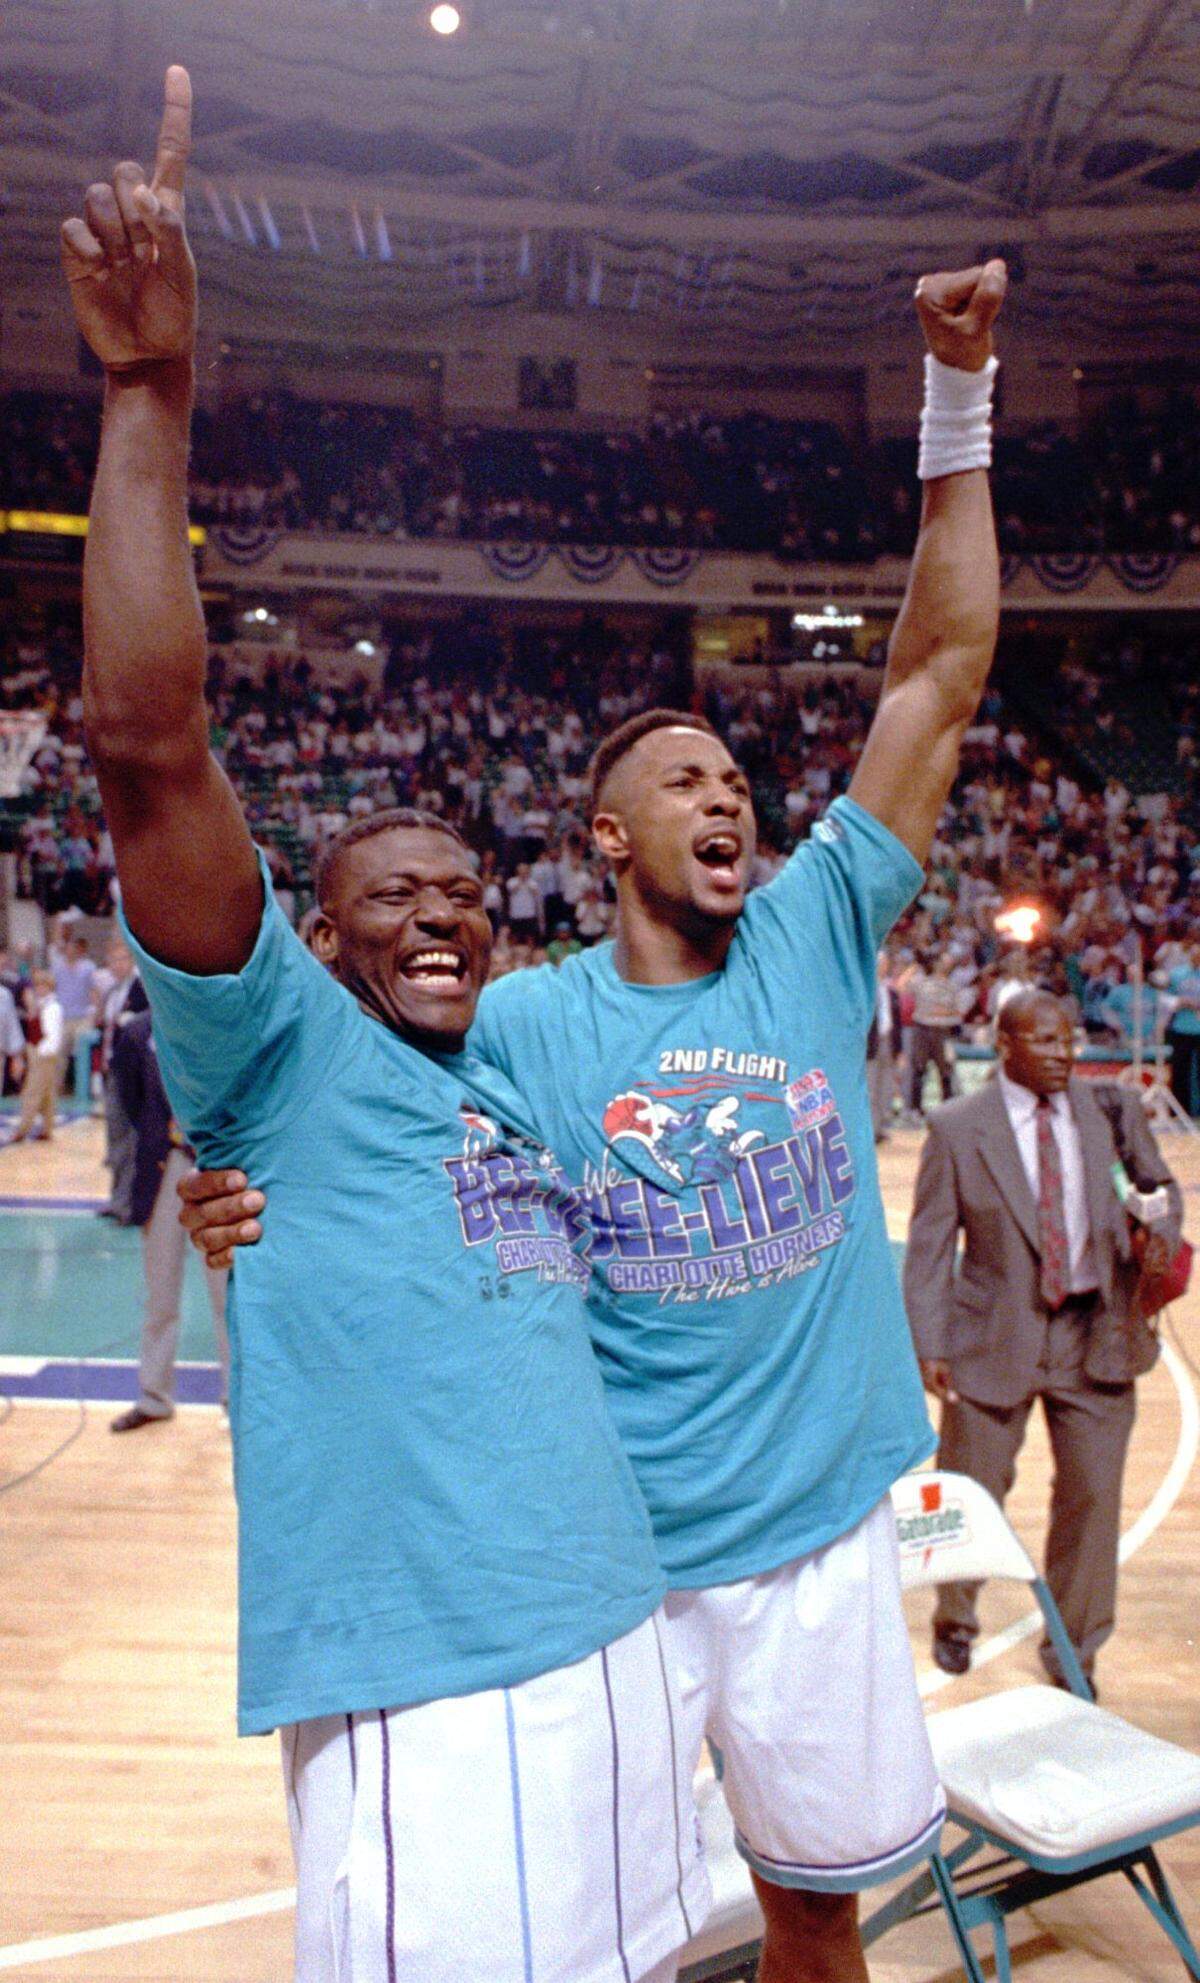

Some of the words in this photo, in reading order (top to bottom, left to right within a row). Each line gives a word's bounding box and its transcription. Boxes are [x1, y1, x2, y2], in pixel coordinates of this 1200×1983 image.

[658, 1049, 707, 1073] 2ND
[711, 1047, 788, 1082] FLIGHT
[570, 1111, 855, 1260] BEE-LIEVE
[583, 1147, 623, 1200] We
[607, 1251, 748, 1293] CHARLOTTE
[750, 1211, 846, 1275] HORNETS
[659, 1282, 700, 1305] The
[706, 1275, 752, 1301] Hive
[776, 1255, 821, 1283] Alive
